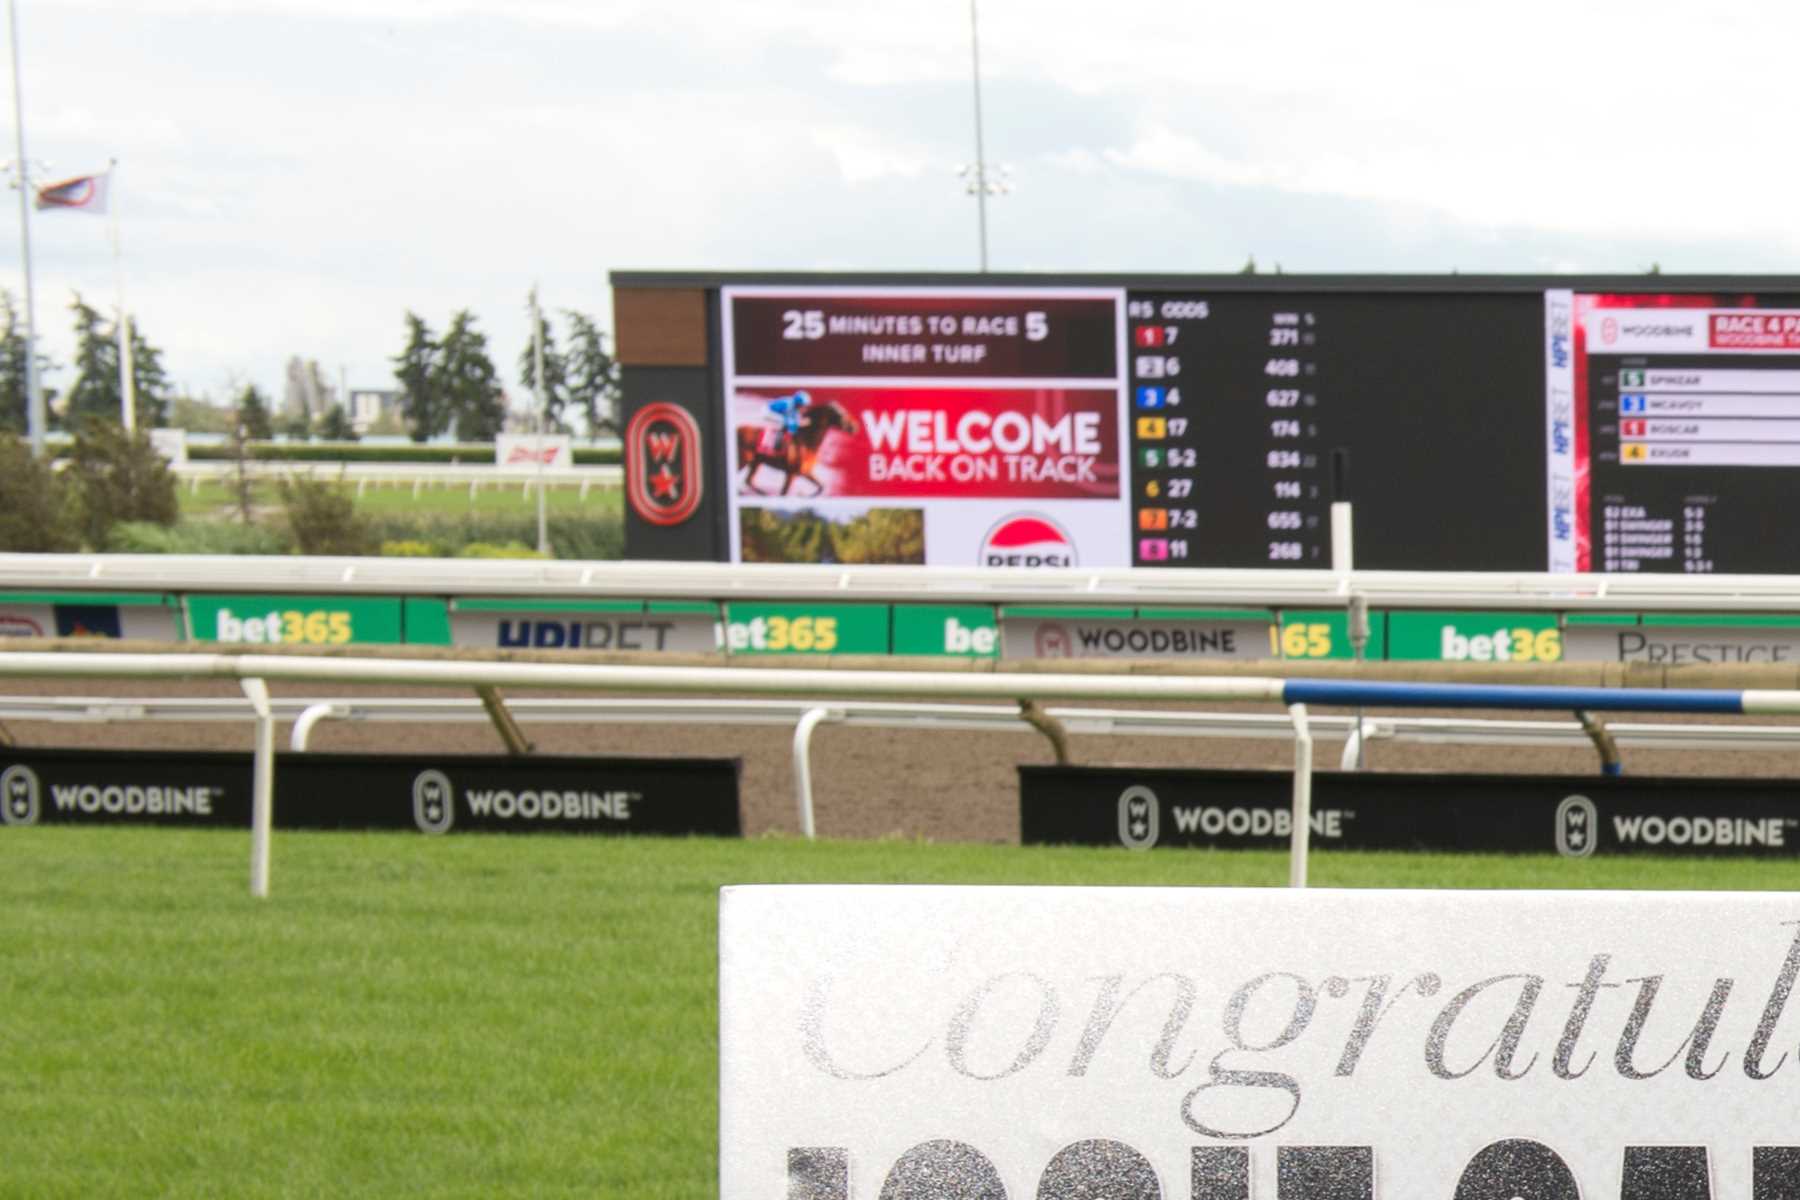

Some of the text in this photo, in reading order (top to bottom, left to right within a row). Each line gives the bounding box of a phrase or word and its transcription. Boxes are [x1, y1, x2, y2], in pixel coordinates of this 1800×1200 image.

[1161, 301, 1209, 319] ODDS
[782, 310, 1048, 341] 25 MINUTES TO RACE 5
[1715, 316, 1764, 333] RACE
[1768, 317, 1780, 333] 4
[1165, 326, 1178, 345] 7
[1269, 328, 1299, 346] 371
[862, 345, 987, 363] INNER TURF
[1166, 357, 1180, 376] 6
[1265, 359, 1299, 376] 408
[1166, 387, 1180, 406] 4
[1266, 389, 1300, 407] 627
[862, 410, 1102, 455] WELCOME
[1167, 418, 1187, 437] 17
[1271, 421, 1300, 437] 174
[646, 432, 680, 463] W
[1145, 449, 1196, 468] 5 5-2
[1267, 450, 1300, 468] 834
[870, 454, 1096, 483] BACK ON TRACK
[1146, 479, 1192, 498] 6 27
[1168, 509, 1197, 528] 7-2
[1169, 540, 1188, 558] 11
[216, 609, 352, 644] bet365
[944, 617, 998, 654] be
[1078, 628, 1237, 655] WOODBINE
[1441, 626, 1561, 662] bet36
[51, 784, 213, 814] WOODBINE
[466, 790, 631, 819] WOODBINE
[1129, 802, 1147, 816] W
[1567, 811, 1585, 826] W
[1172, 806, 1342, 837] WOODBNE
[1613, 816, 1784, 846] WOODBINE
